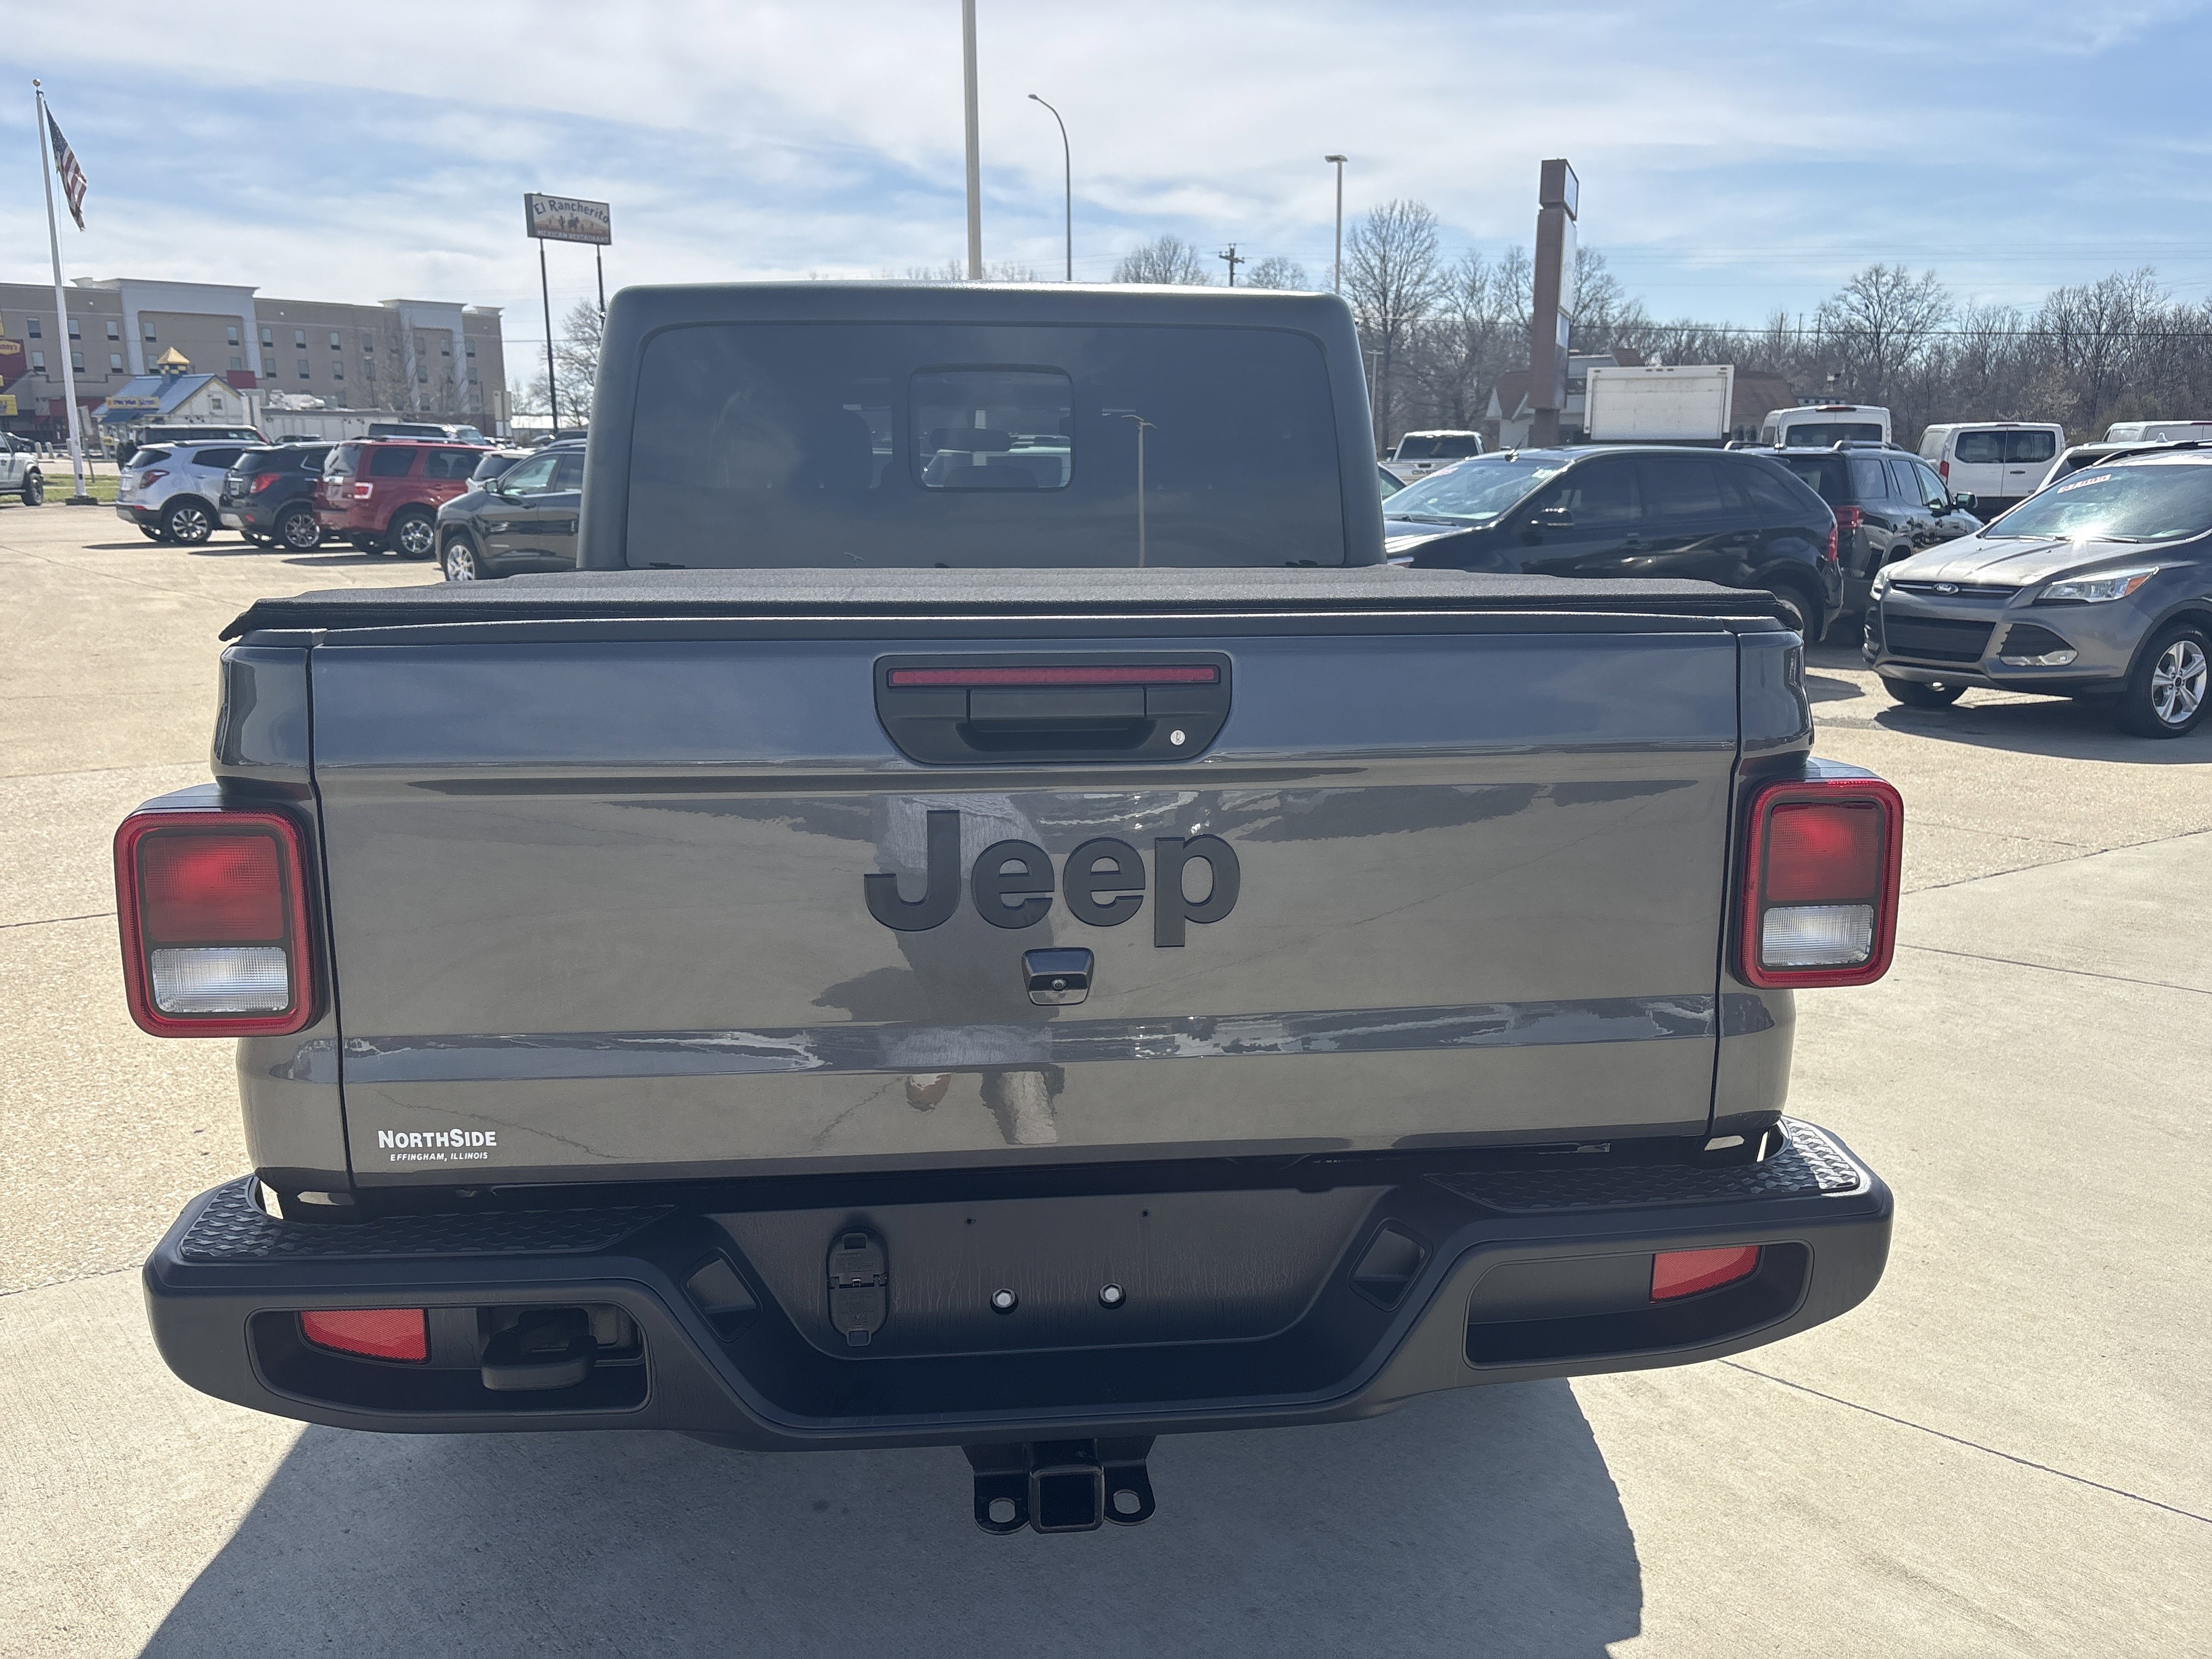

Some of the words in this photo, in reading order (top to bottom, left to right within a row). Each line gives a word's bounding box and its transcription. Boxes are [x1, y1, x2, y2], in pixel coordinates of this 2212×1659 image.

[534, 201, 546, 215] El
[548, 199, 610, 223] Rancherito
[864, 809, 1240, 948] Jeep
[390, 1153, 448, 1162] EFFINGHAM,
[450, 1152, 488, 1160] ILLINOIS
